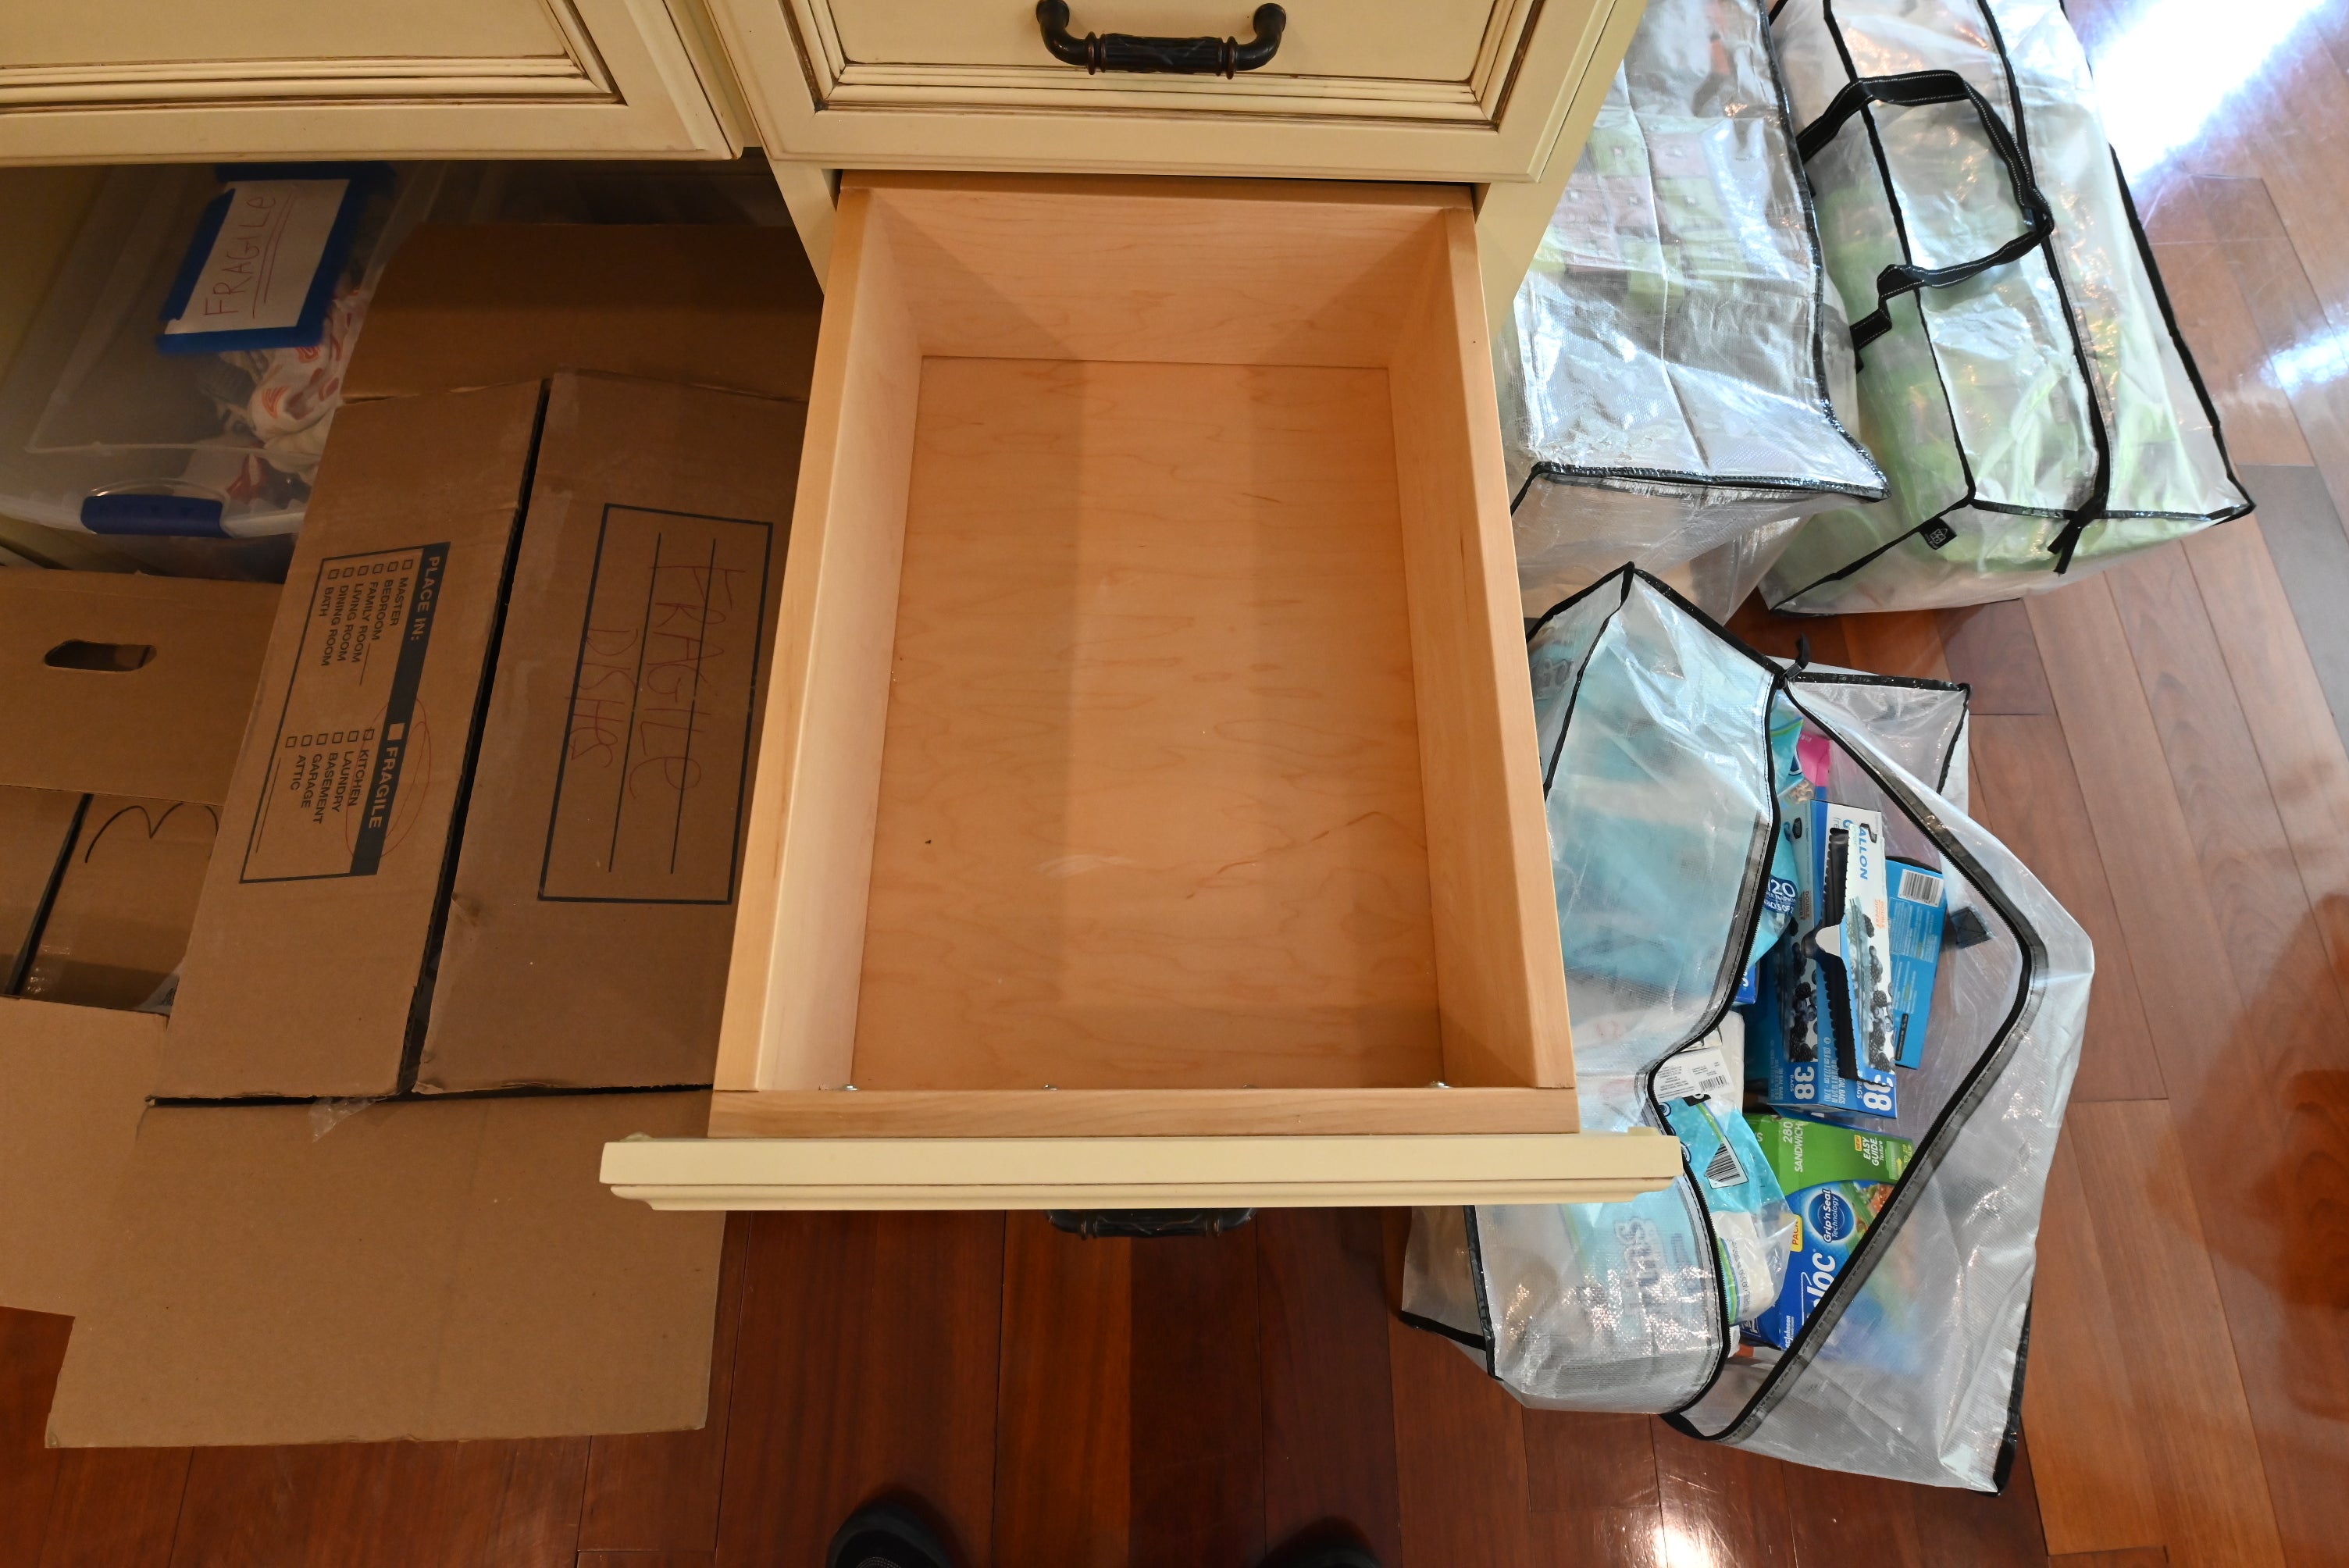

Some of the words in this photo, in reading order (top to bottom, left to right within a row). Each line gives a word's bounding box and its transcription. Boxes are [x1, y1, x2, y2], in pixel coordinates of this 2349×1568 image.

[319, 586, 334, 617] BATH
[347, 583, 364, 621] LIVING
[362, 581, 379, 622] FAMILY
[390, 577, 409, 626] MASTER
[416, 556, 440, 613] PLACE
[330, 584, 349, 625] DINING
[372, 579, 394, 640] BEDROOM
[321, 629, 338, 666] ROOM
[337, 624, 354, 661] ROOM
[351, 625, 369, 663] ROOM
[411, 618, 427, 641] IN:
[290, 754, 306, 791] ATTIC
[301, 754, 323, 808] GARAGE
[313, 752, 338, 825] BASEMENT
[331, 750, 355, 813] LAUNDRY
[348, 749, 369, 807] KITCHEN
[368, 747, 399, 829] FRAGILE
[1794, 1066, 1815, 1100] 38
[1782, 1121, 1794, 1144] 280
[1794, 1123, 1805, 1173] SANDWICH
[1862, 1136, 1871, 1160] EASY
[1870, 1138, 1880, 1167] GUIDE
[1822, 1188, 1831, 1212] Seal
